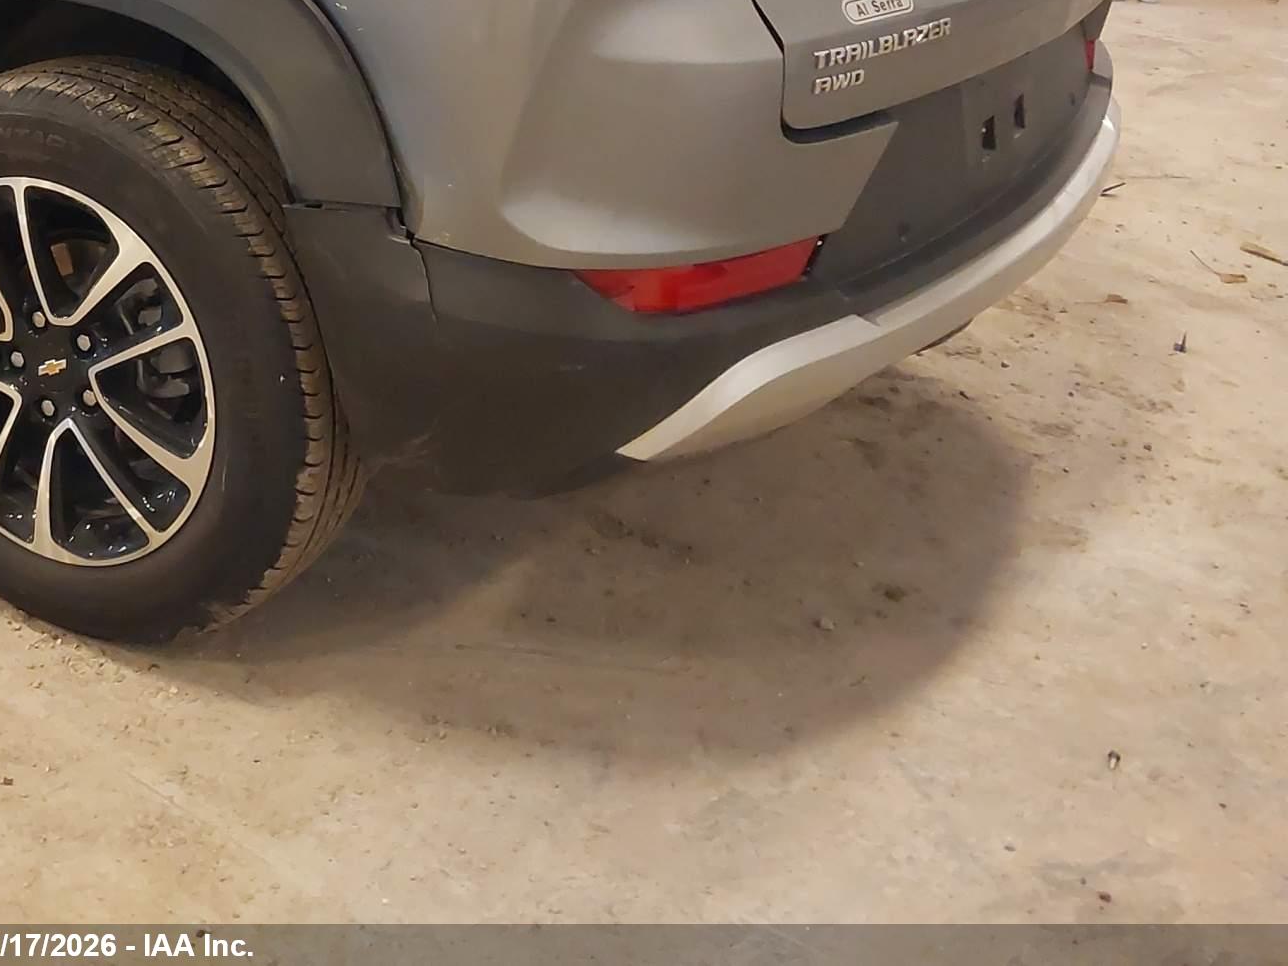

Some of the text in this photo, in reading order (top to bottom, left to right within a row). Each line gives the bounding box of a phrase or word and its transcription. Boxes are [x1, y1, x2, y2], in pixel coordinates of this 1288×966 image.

[855, 3, 870, 18] Al
[813, 17, 952, 70] TRAILBLAZER
[814, 68, 865, 96] AWD
